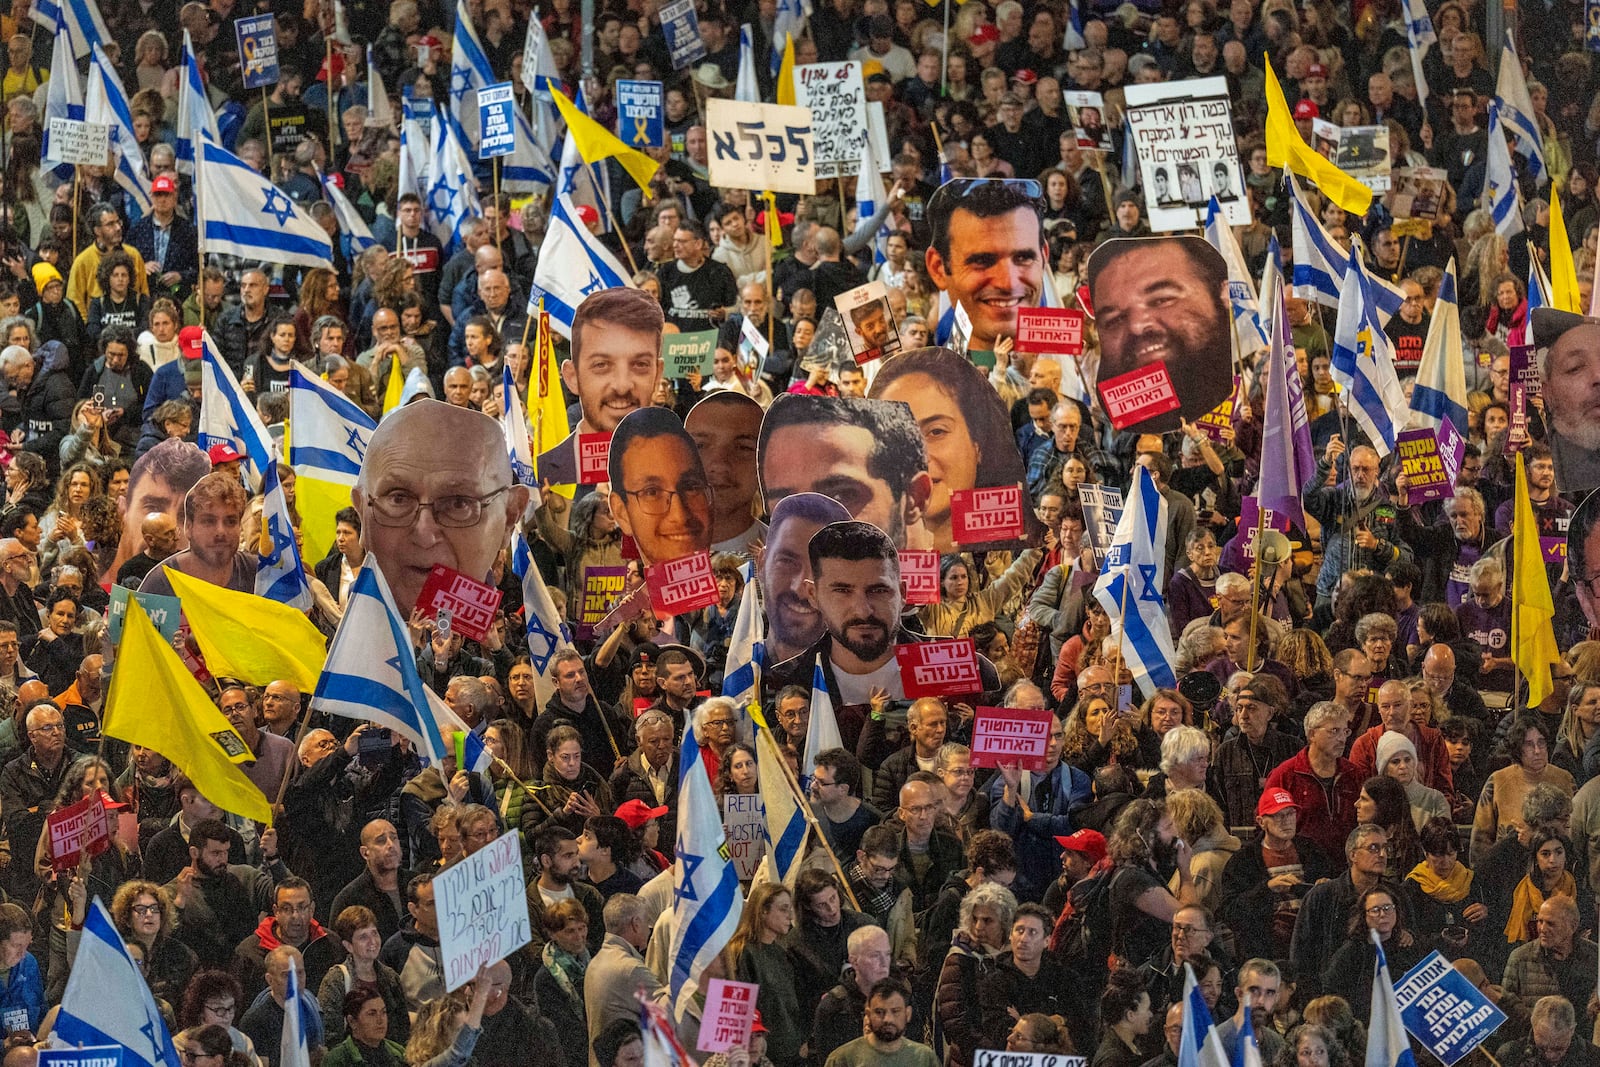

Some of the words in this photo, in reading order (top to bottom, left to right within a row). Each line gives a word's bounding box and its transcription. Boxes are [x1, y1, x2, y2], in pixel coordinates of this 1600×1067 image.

[620, 93, 660, 106] חופשיים
[488, 104, 503, 115] בעד
[486, 124, 509, 136] חקירה
[482, 134, 514, 148] ממלכתית
[1022, 317, 1061, 328] החטוף
[1064, 318, 1079, 328] עד
[1027, 330, 1072, 342] האחרון
[1399, 336, 1422, 348] כולנו
[668, 344, 698, 355] מרפים
[698, 341, 711, 353] לא
[674, 356, 699, 365] שכולם
[1145, 373, 1163, 386] עד
[1107, 379, 1145, 400] החטוף
[1117, 389, 1163, 413] האחרון
[1398, 438, 1436, 460] עסקה
[1401, 454, 1442, 475] מלאה
[975, 490, 1018, 509] עדיין
[967, 511, 1019, 529] בעזה.
[666, 555, 707, 582] עדיין
[900, 554, 935, 569] עדיי
[453, 577, 498, 606] עדיין
[587, 576, 626, 595] עסקה
[665, 576, 714, 602] בעזה.
[585, 592, 619, 610] לאה
[922, 643, 969, 662] עדיין
[918, 664, 976, 683] בעזה.
[980, 719, 1023, 733] החטוף
[1029, 723, 1045, 735] עד
[984, 737, 1035, 752] האחרון
[92, 804, 102, 818] עד
[728, 796, 763, 813] RETU
[728, 823, 765, 841] HOSTA
[473, 849, 486, 887] לא
[1411, 959, 1447, 989] אנחנו
[1416, 986, 1447, 1010] בעד
[1424, 993, 1460, 1025] ועדת
[1430, 1000, 1474, 1038] חקירה
[1433, 1005, 1494, 1056] ממלכתית
